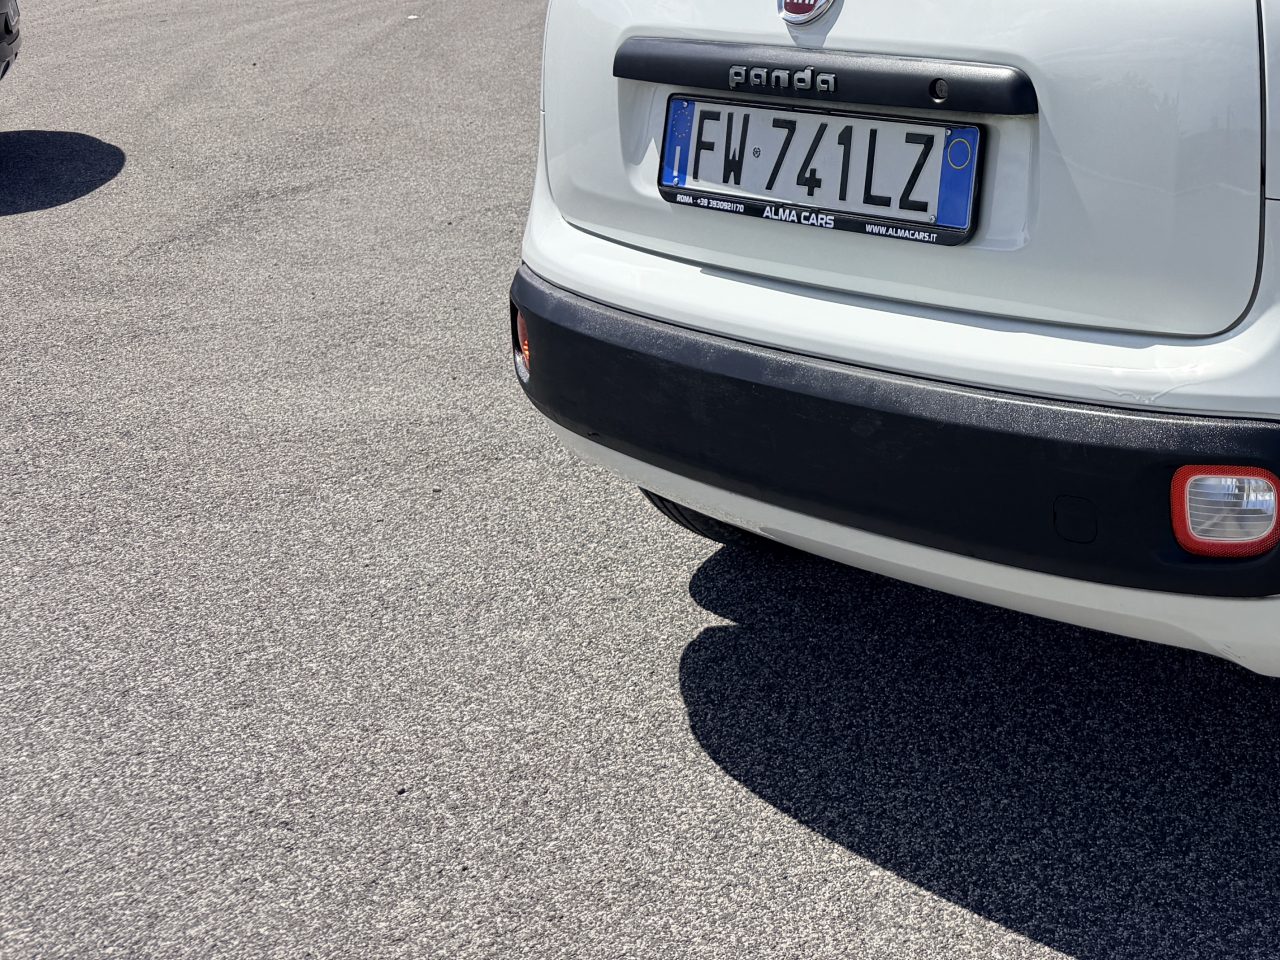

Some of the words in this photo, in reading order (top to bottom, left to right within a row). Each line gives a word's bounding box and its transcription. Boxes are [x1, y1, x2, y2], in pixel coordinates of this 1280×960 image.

[728, 65, 836, 92] panda
[692, 110, 750, 186] FW
[765, 117, 935, 213] 741LZ
[676, 194, 693, 204] ROMA
[697, 197, 708, 207] +39
[762, 206, 798, 223] ALMA
[800, 211, 835, 229] CARS
[865, 223, 938, 243] WWW.ALMACARS.IT
